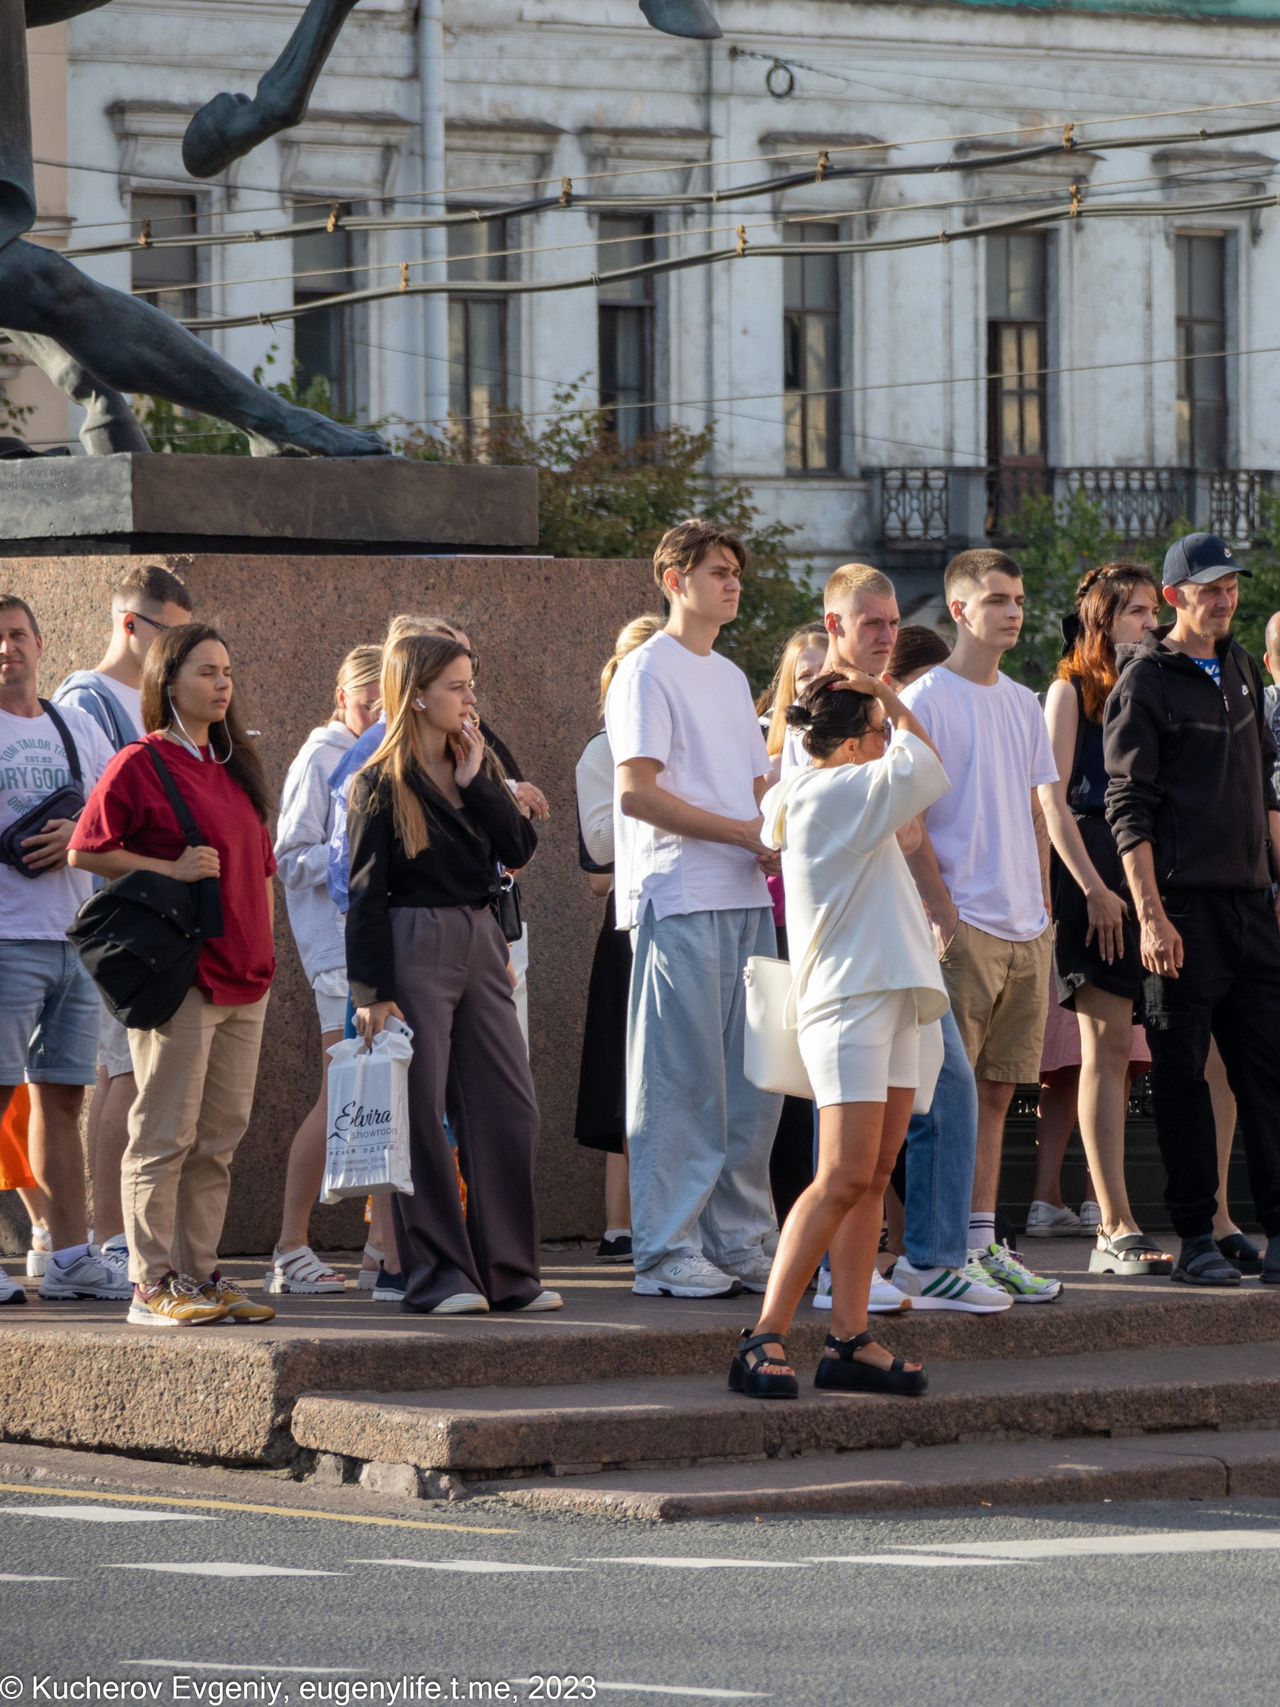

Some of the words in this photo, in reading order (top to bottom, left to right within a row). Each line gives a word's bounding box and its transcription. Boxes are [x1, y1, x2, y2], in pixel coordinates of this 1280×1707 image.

[0, 744, 20, 762] TOM
[16, 738, 51, 751] TAILOR
[335, 1101, 393, 1131] Elvira
